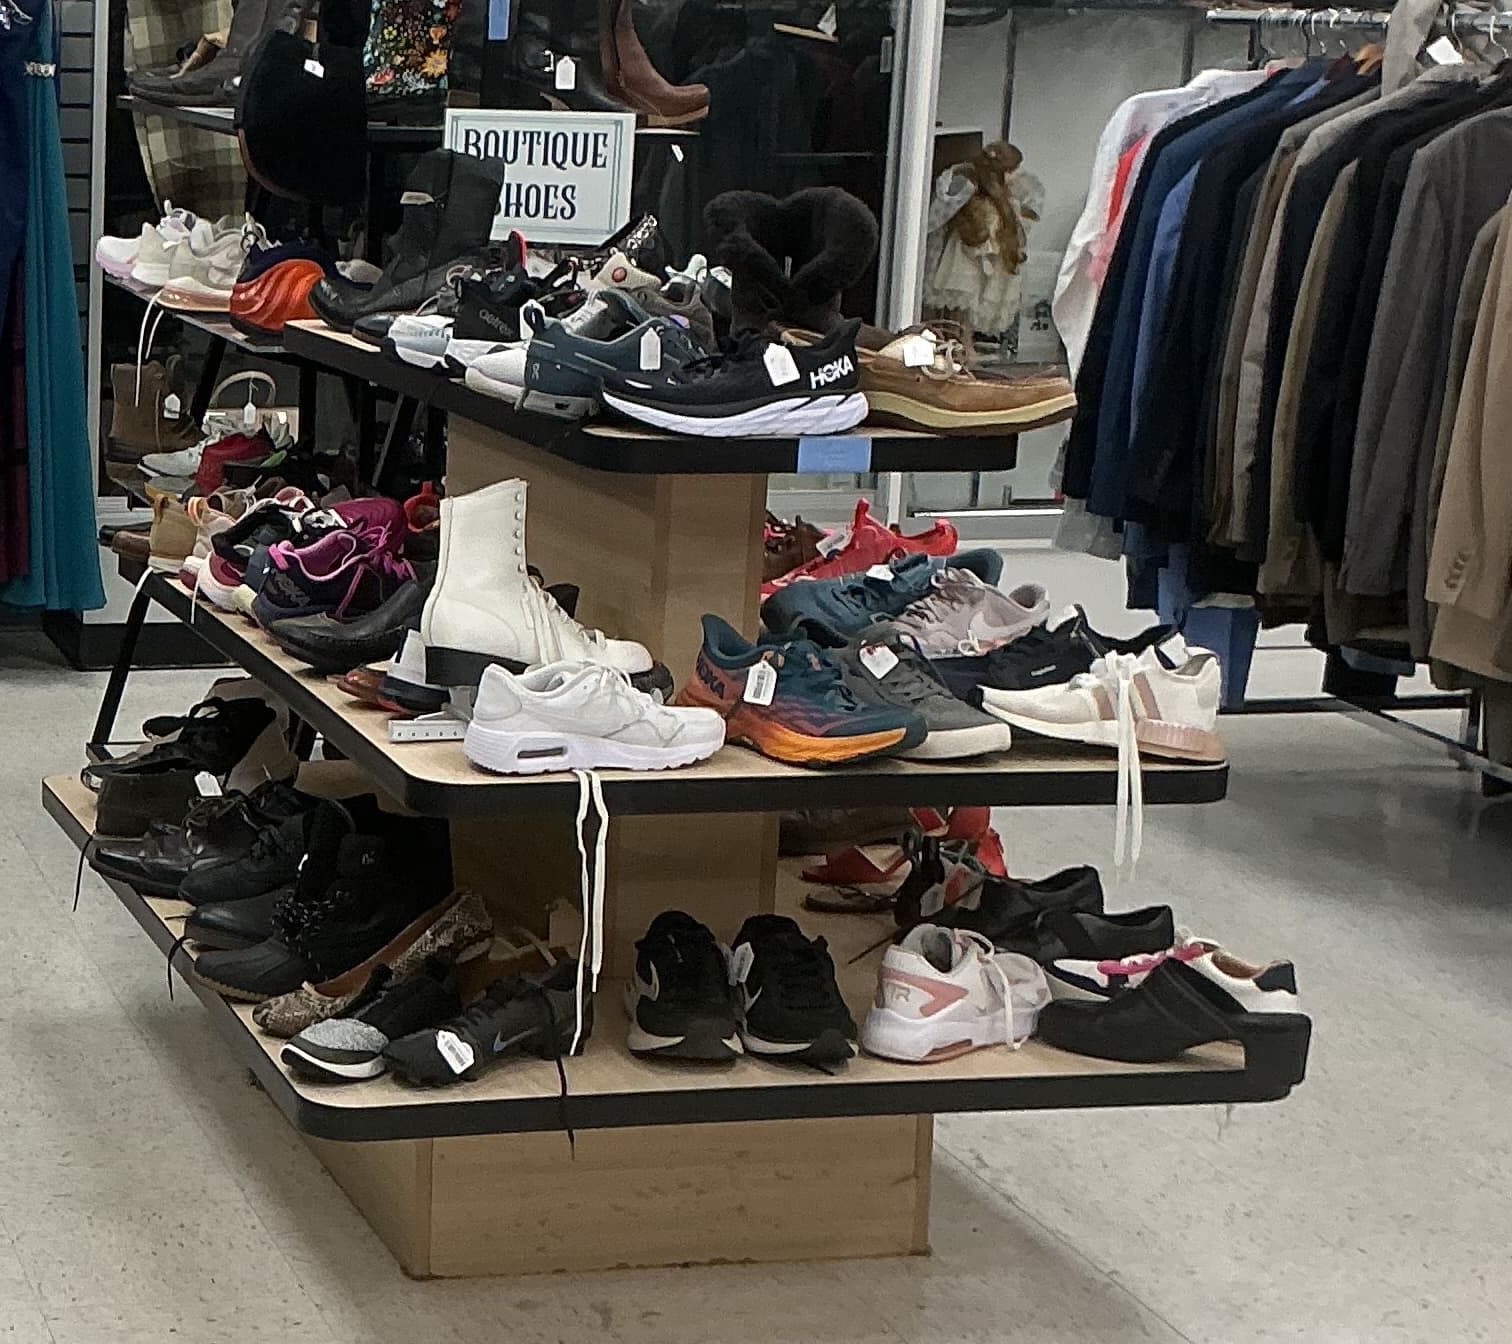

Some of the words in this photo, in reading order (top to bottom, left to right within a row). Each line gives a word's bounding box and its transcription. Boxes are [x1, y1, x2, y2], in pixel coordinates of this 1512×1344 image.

[463, 128, 609, 171] BOUTIQUE
[493, 182, 577, 221] HOES
[809, 354, 855, 390] HOKA
